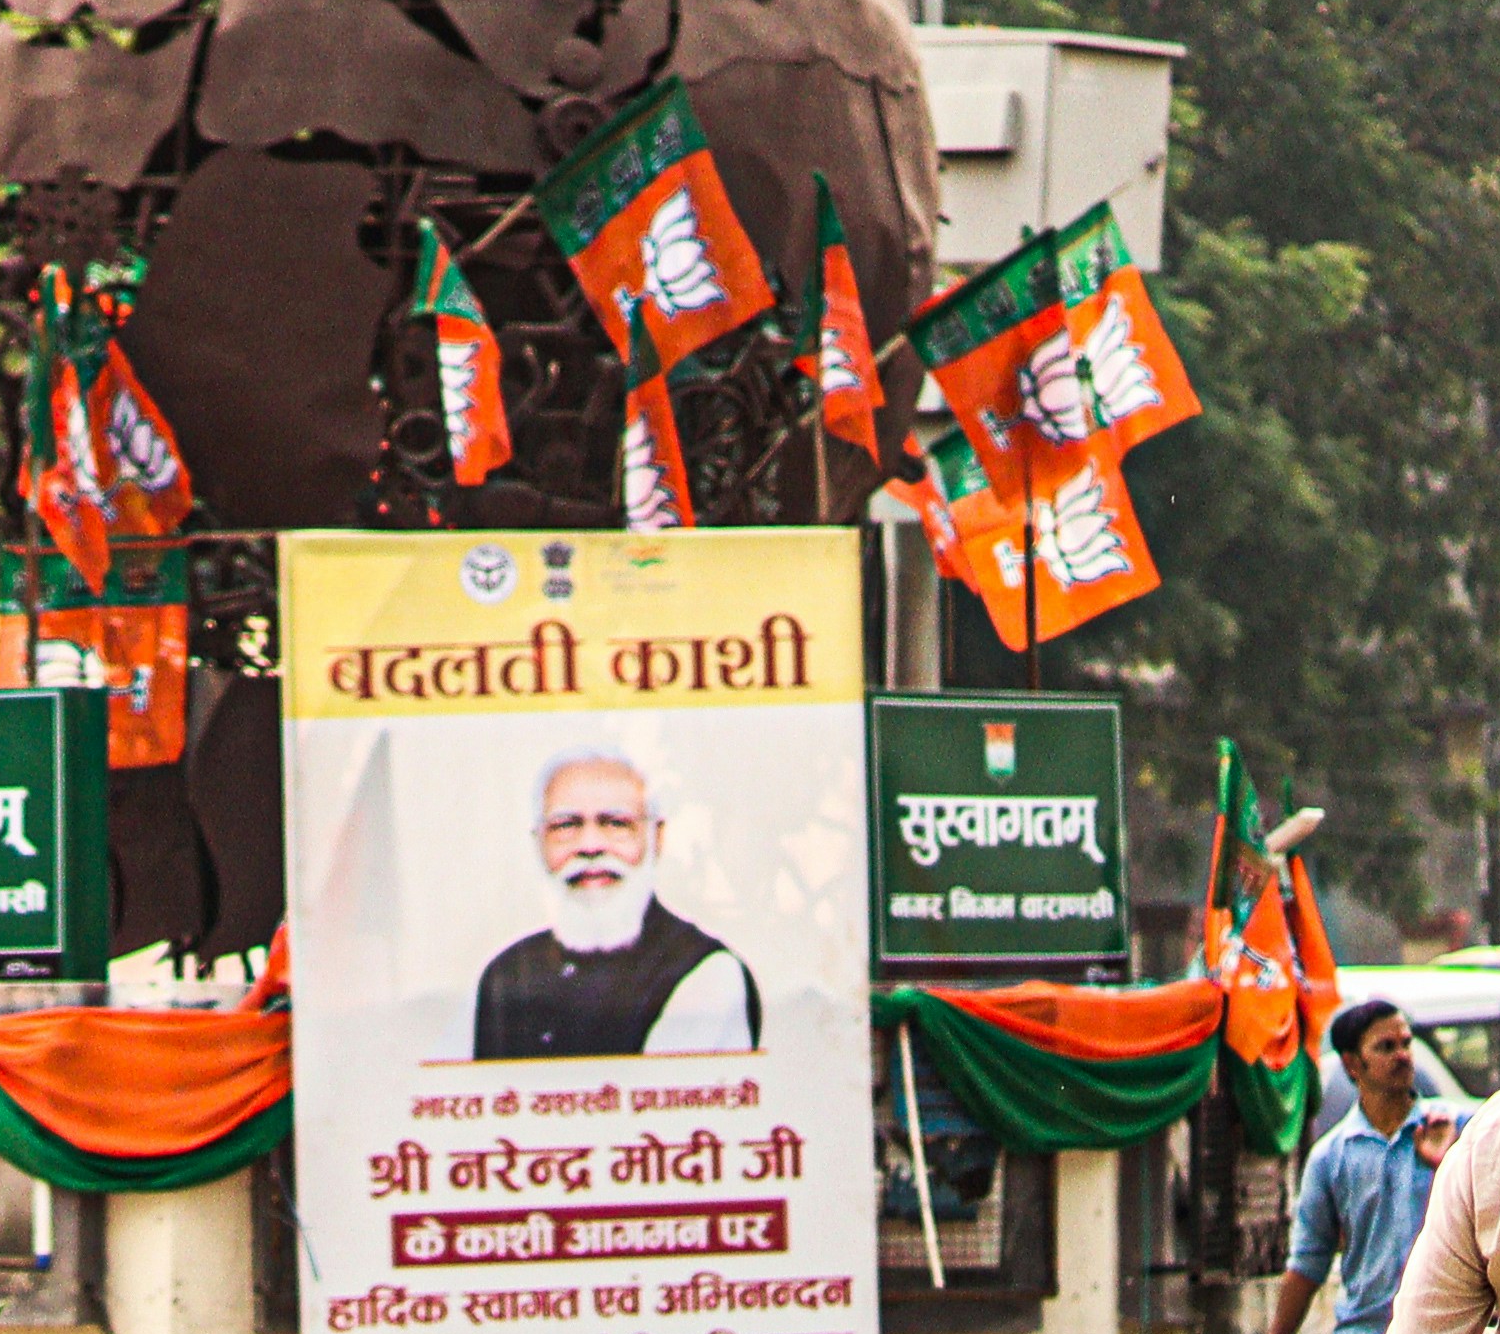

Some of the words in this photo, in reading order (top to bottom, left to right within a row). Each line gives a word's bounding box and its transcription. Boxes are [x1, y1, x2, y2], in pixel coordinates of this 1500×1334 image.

[325, 619, 584, 699] बदलती
[608, 614, 813, 692] काशी
[897, 795, 1106, 866] सुस्वागतम्
[369, 1139, 429, 1198] श्री
[448, 1138, 593, 1193] नरेन्द्र
[611, 1131, 724, 1185] मोदी
[740, 1125, 804, 1179] जी
[404, 1216, 445, 1260] के
[455, 1211, 555, 1258] काशी
[565, 1215, 708, 1254] आगमन
[718, 1212, 774, 1249] पर
[327, 1284, 449, 1332] हार्दिक
[462, 1287, 579, 1325] स्वागत
[593, 1274, 640, 1317] एवं
[656, 1272, 853, 1315] अभिनन्दन
